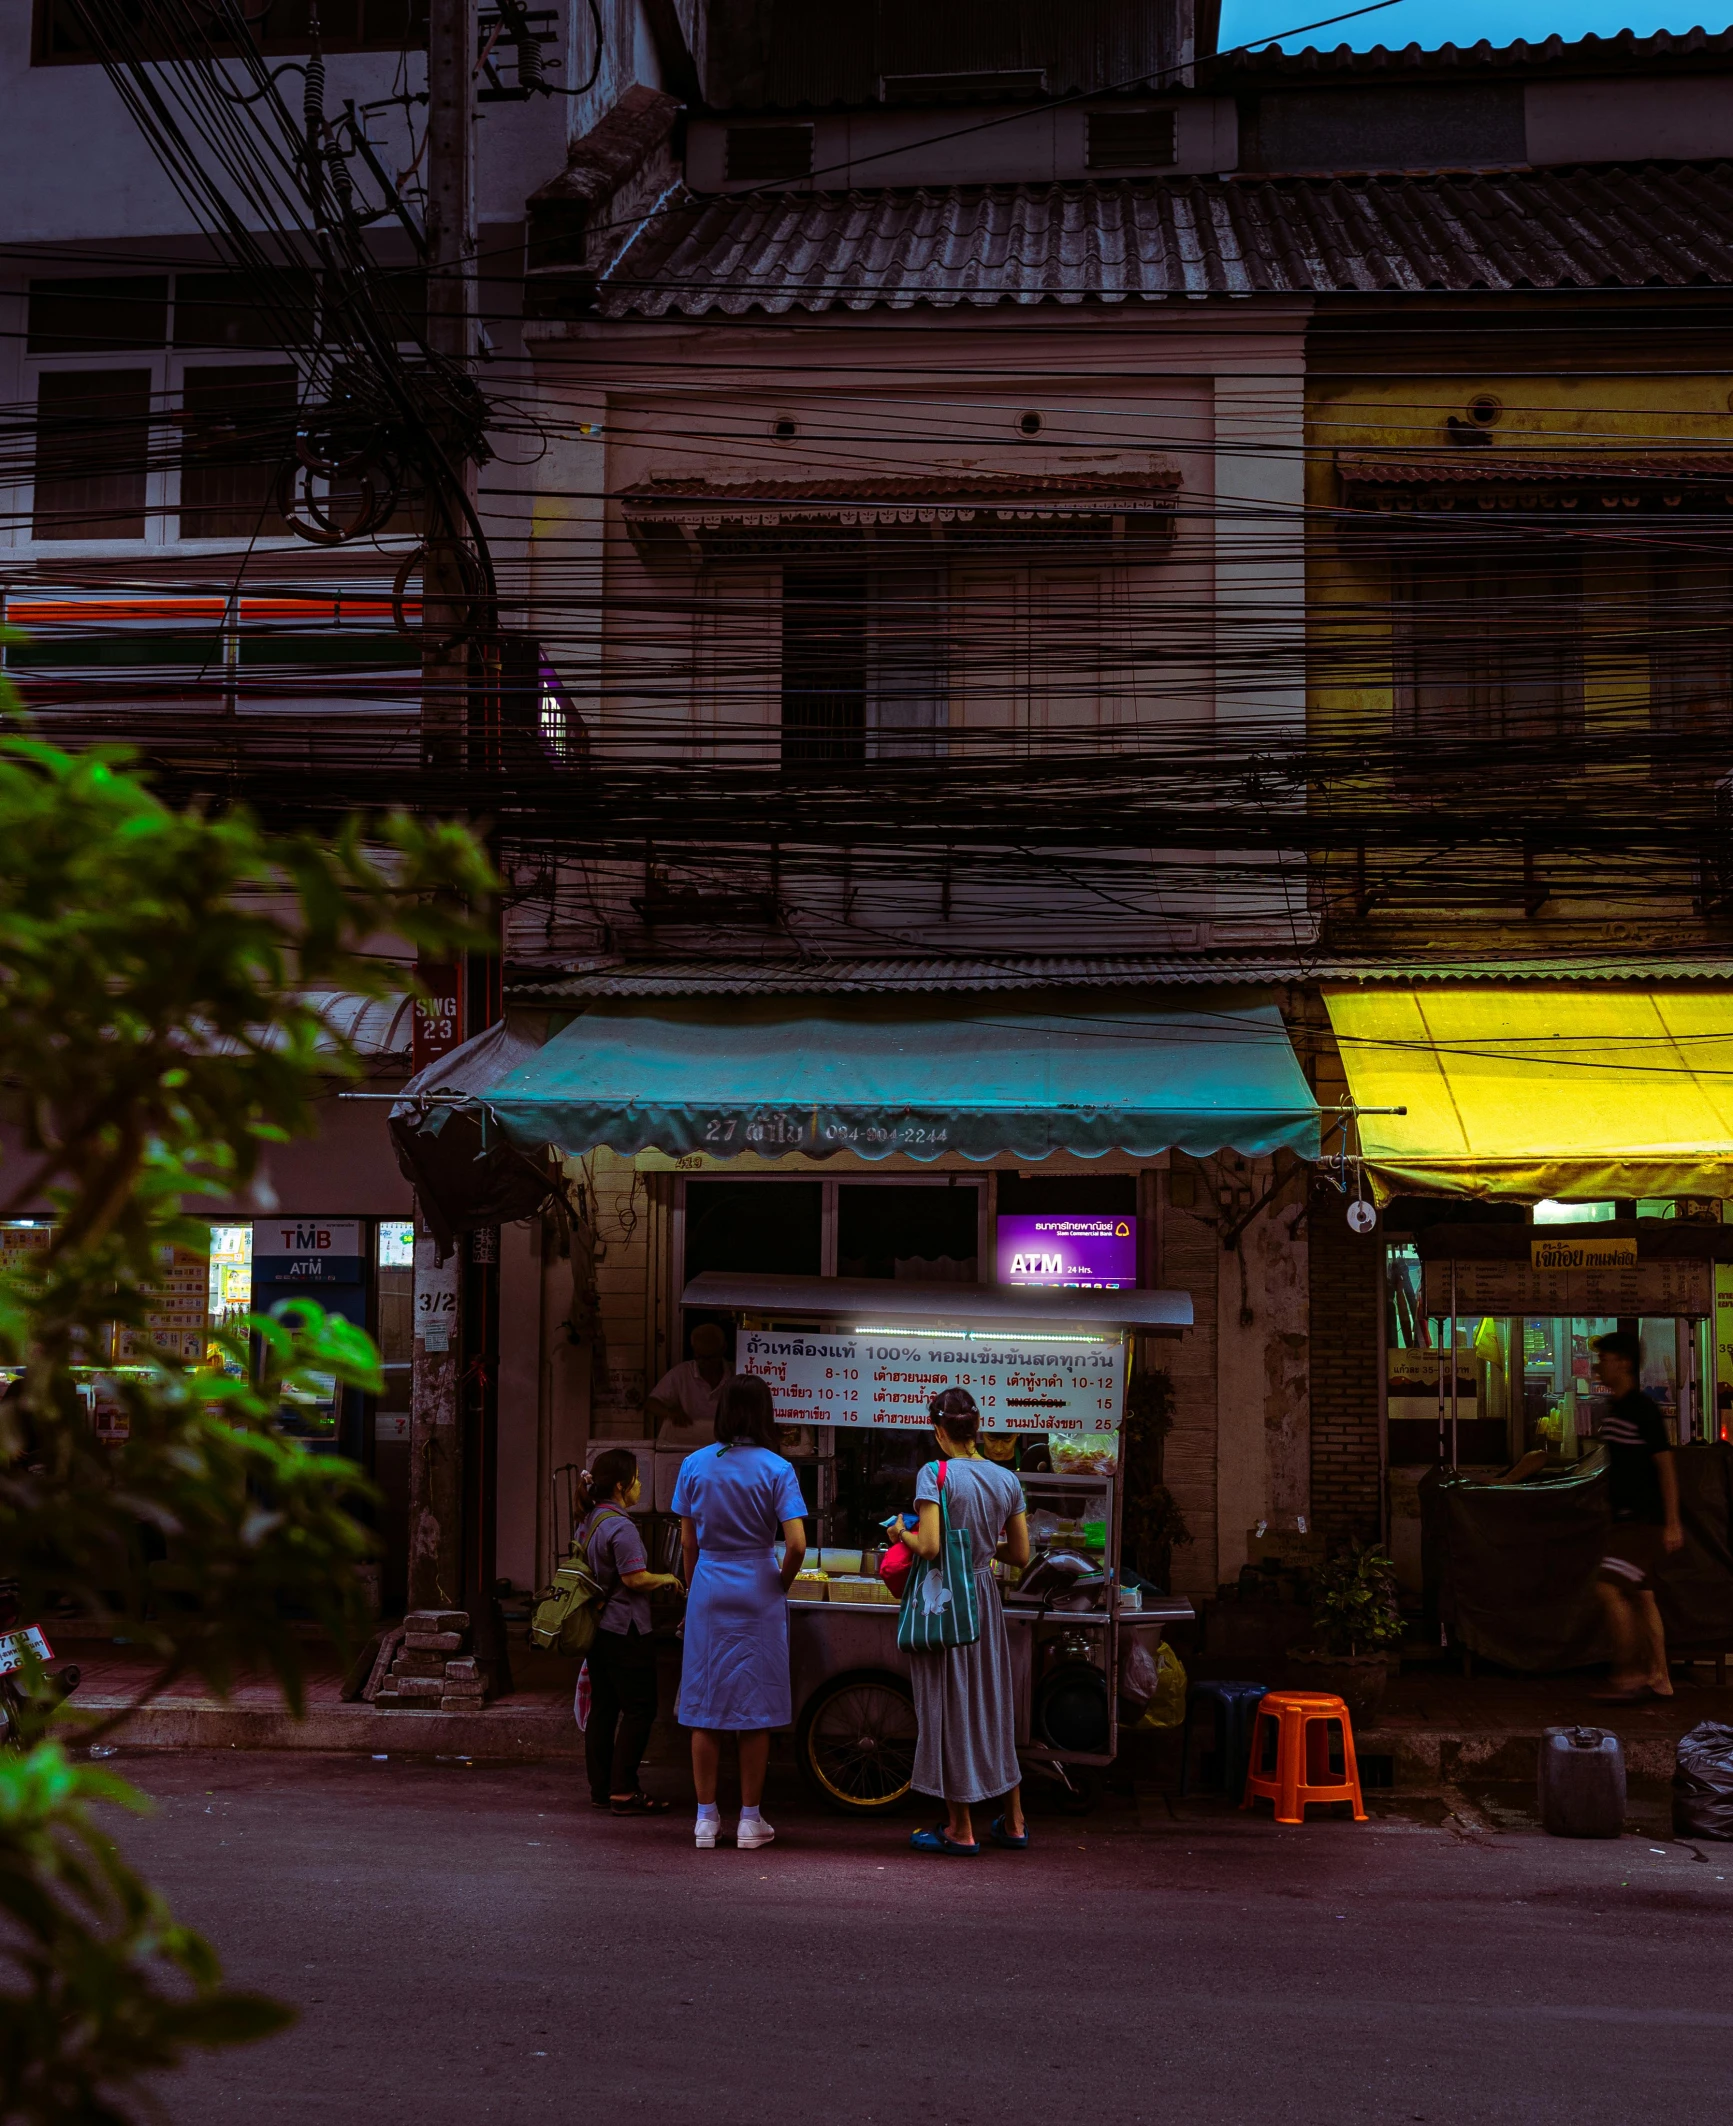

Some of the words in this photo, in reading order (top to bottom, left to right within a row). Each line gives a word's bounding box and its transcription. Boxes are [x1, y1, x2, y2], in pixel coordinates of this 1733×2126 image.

[415, 997, 457, 1017] SWG
[423, 1019, 453, 1039] 23
[705, 1119, 738, 1141] 27
[826, 1124, 948, 1143] 084-904-2244
[1035, 1221, 1113, 1230] ธนาคารไทยพาณิชย์
[280, 1226, 332, 1249] TMB
[289, 1260, 322, 1275] ATM
[1009, 1253, 1063, 1274] ATM
[1067, 1266, 1077, 1274] 24
[1078, 1266, 1093, 1274] Hrs.
[419, 1291, 456, 1312] 3/2
[746, 1334, 858, 1358] ถั่วเหลืองแท้
[866, 1346, 921, 1362] 100%
[928, 1347, 1114, 1373] หอมเข้มข้นสดทุกวัน
[825, 1367, 859, 1380] 8-10
[873, 1366, 948, 1384] เต้าฮวยนมสด
[955, 1373, 996, 1386] 13-15
[1006, 1371, 1063, 1392] เต้าหู้งาดำ
[1071, 1377, 1113, 1389] 10-12
[1422, 1366, 1450, 1374] 35-0
[818, 1388, 859, 1401] 10-12
[980, 1395, 996, 1406] 12
[1097, 1398, 1112, 1409] 15
[842, 1411, 858, 1422] 15
[980, 1416, 995, 1428] 15
[1095, 1419, 1112, 1430] 25
